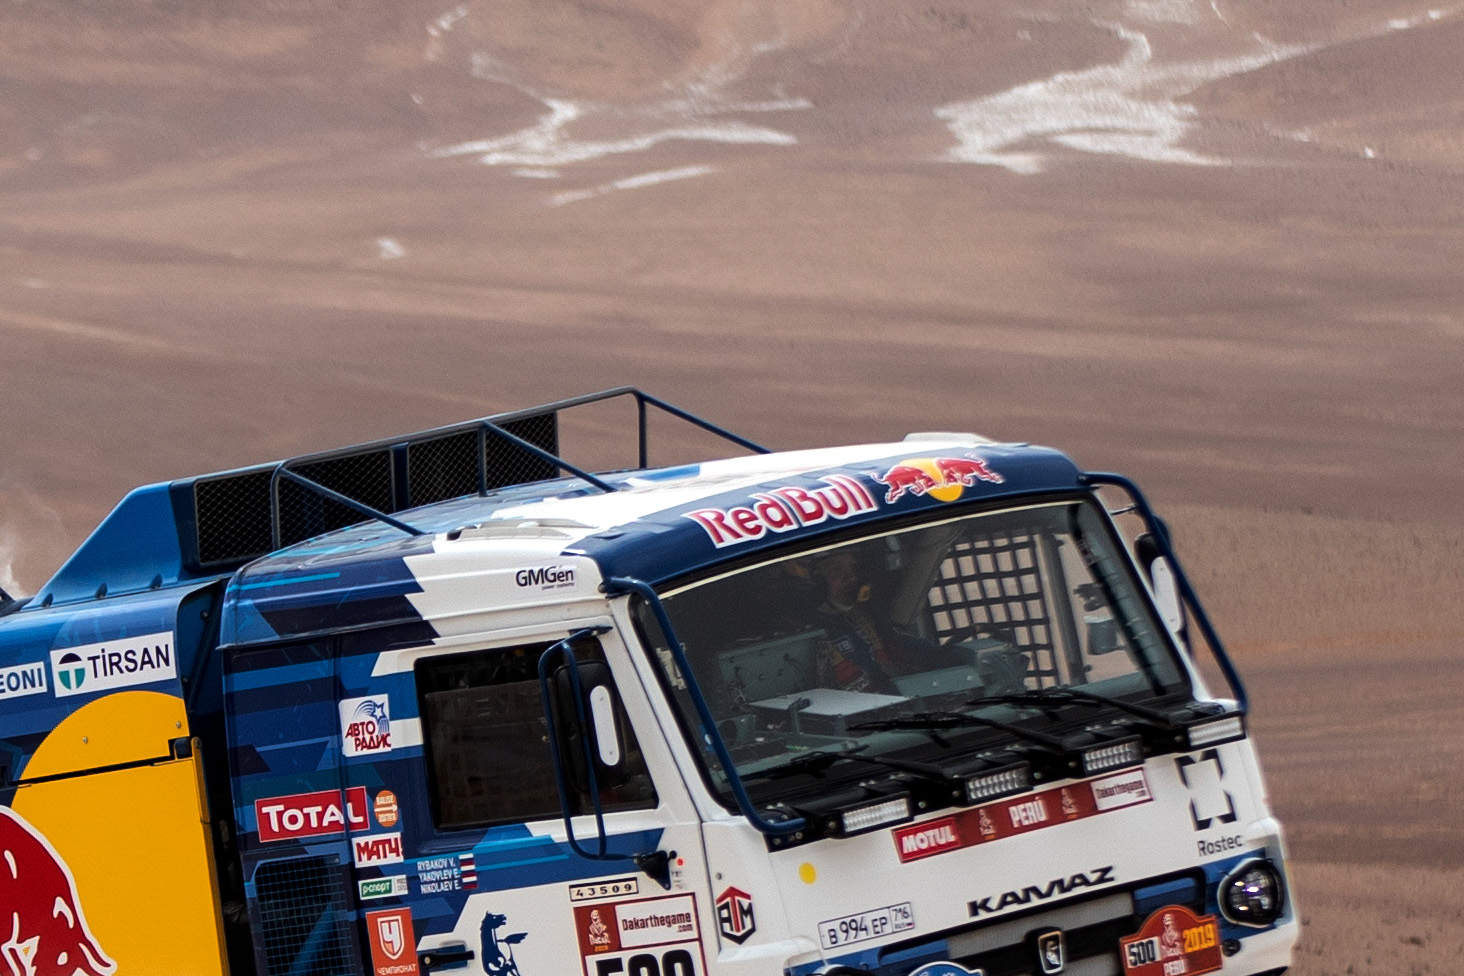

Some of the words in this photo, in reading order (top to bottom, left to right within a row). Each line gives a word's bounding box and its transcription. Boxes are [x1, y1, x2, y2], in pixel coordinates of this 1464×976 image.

[682, 493, 800, 549] Red
[775, 474, 880, 526] Bull
[901, 826, 956, 854] MOTUL
[1197, 834, 1243, 857] Rostec
[417, 858, 447, 871] RYBAKOV
[419, 869, 452, 883] YAKOVLEV
[420, 881, 453, 895] NIKOLAEV
[576, 884, 633, 898] 43509
[967, 865, 1115, 917] KAMAZ
[621, 912, 692, 931] Dakarthegame
[1128, 940, 1156, 967] 500
[1183, 923, 1215, 953] 2019
